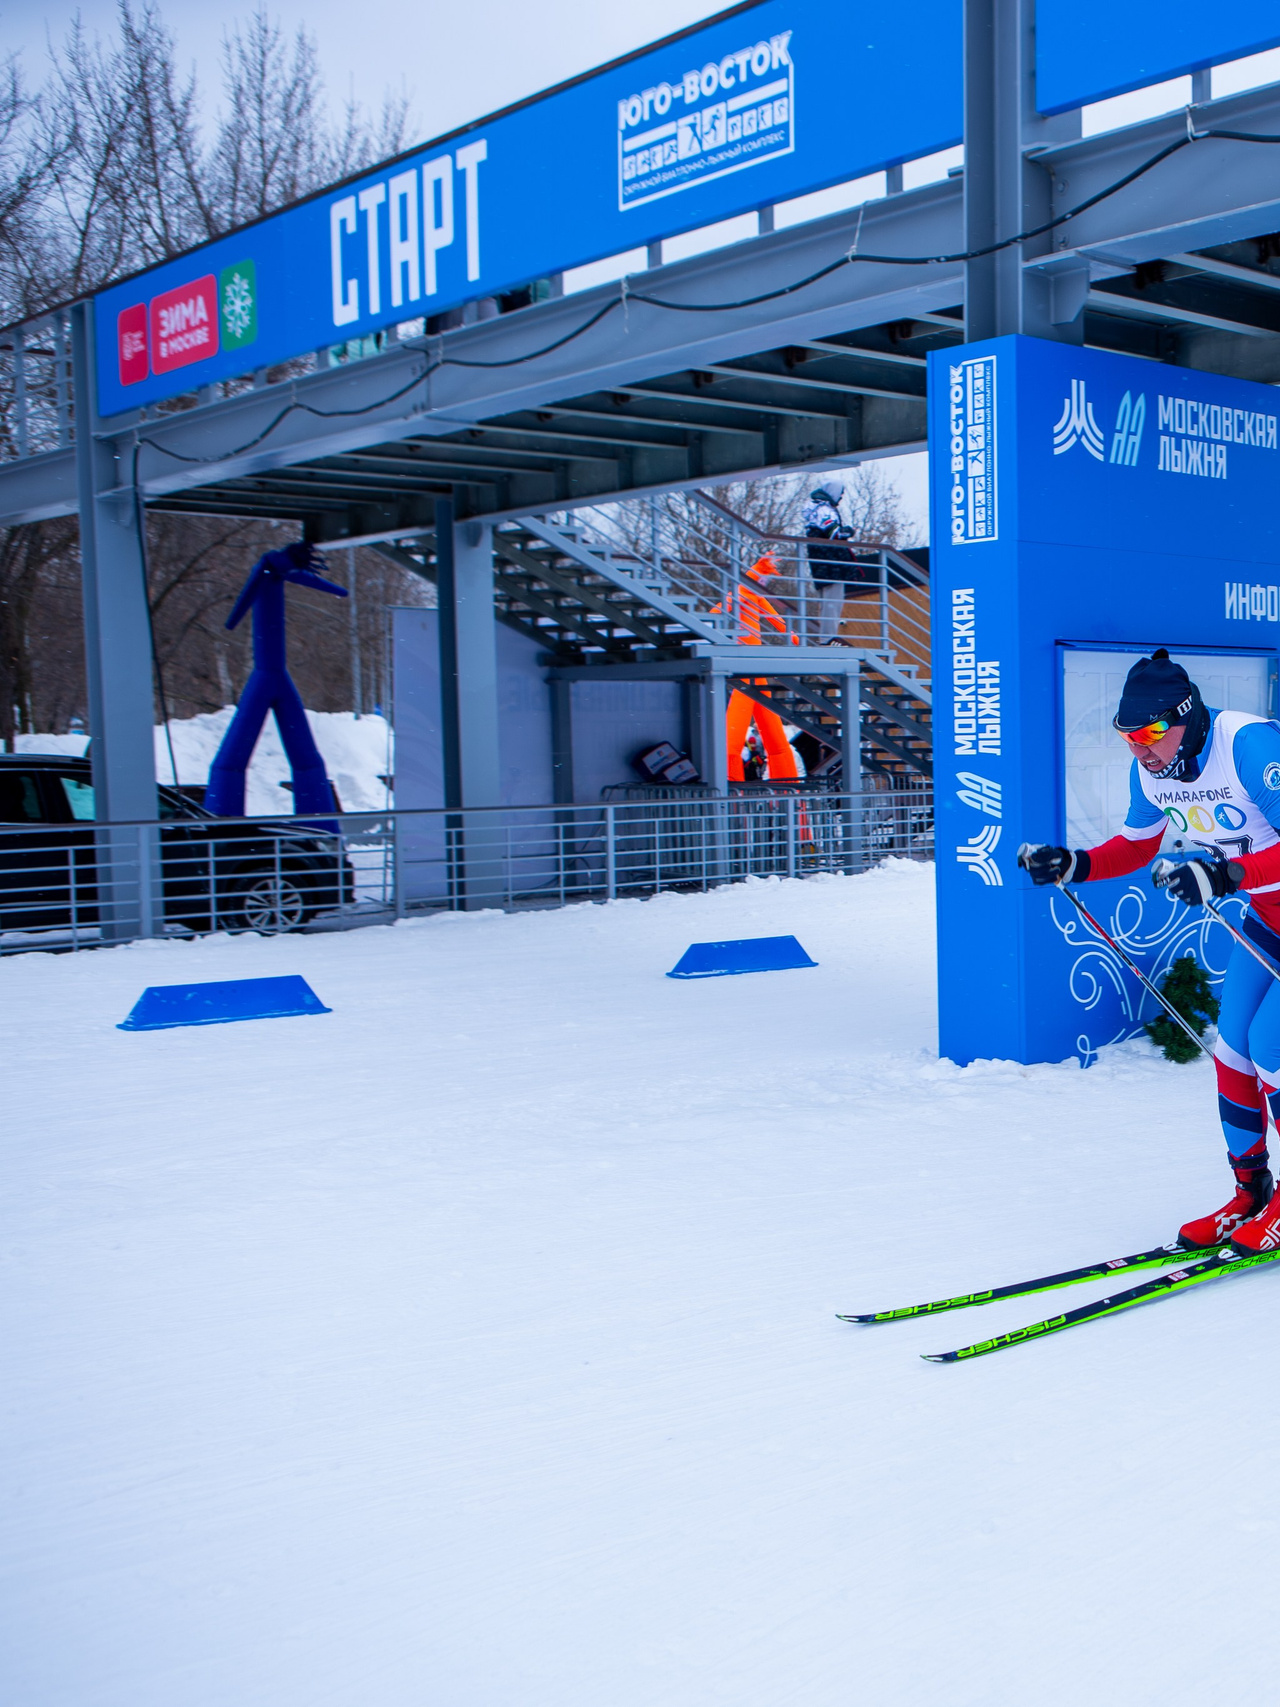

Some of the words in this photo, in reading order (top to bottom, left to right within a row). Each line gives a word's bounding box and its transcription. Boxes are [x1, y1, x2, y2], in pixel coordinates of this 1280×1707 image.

[618, 30, 793, 131] ЮГО-ВОСТОК
[330, 138, 488, 327] СТАРТ
[158, 295, 209, 338] ЗИМА
[169, 326, 210, 355] МОСКВЕ
[1158, 394, 1277, 450] МОСКОВСКАЯ
[949, 364, 966, 545] ЮГО-ВОСТОК
[1158, 435, 1227, 480] ЛЫЖНЯ
[952, 588, 977, 755] МОСКОВСКАЯ
[977, 661, 1001, 755] ЛЫЖНЯ
[1154, 787, 1233, 804] VMARAFONE
[1219, 1252, 1277, 1275] FISCHER
[875, 1290, 993, 1320] FISCHER
[957, 1315, 1067, 1358] FISCHER
